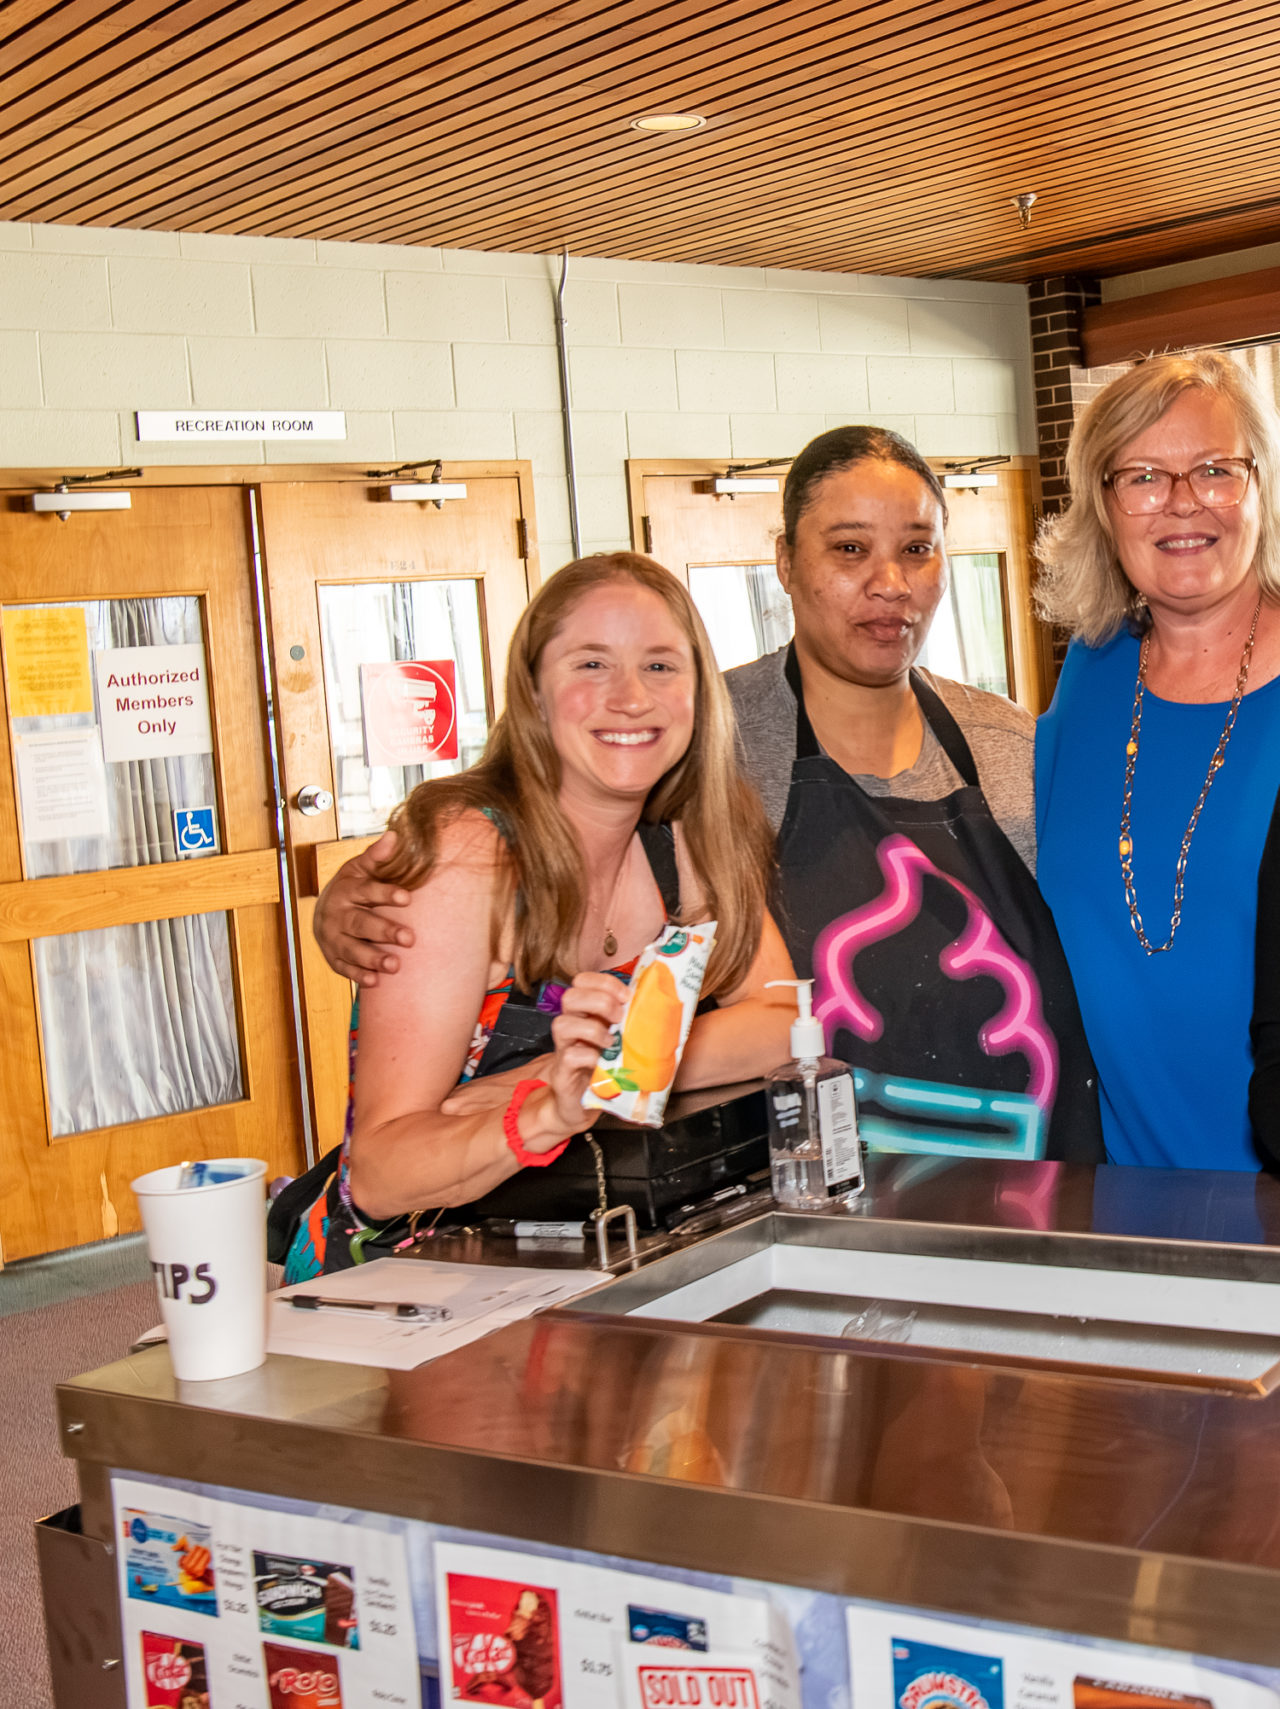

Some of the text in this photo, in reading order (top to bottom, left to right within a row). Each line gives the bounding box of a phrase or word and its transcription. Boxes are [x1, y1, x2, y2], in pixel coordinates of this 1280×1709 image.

[175, 419, 314, 432] RECREATION ROOM
[107, 667, 200, 688] Authorized
[116, 694, 194, 712] Members
[137, 718, 177, 736] Only
[647, 1674, 750, 1708] SOLD OUT
